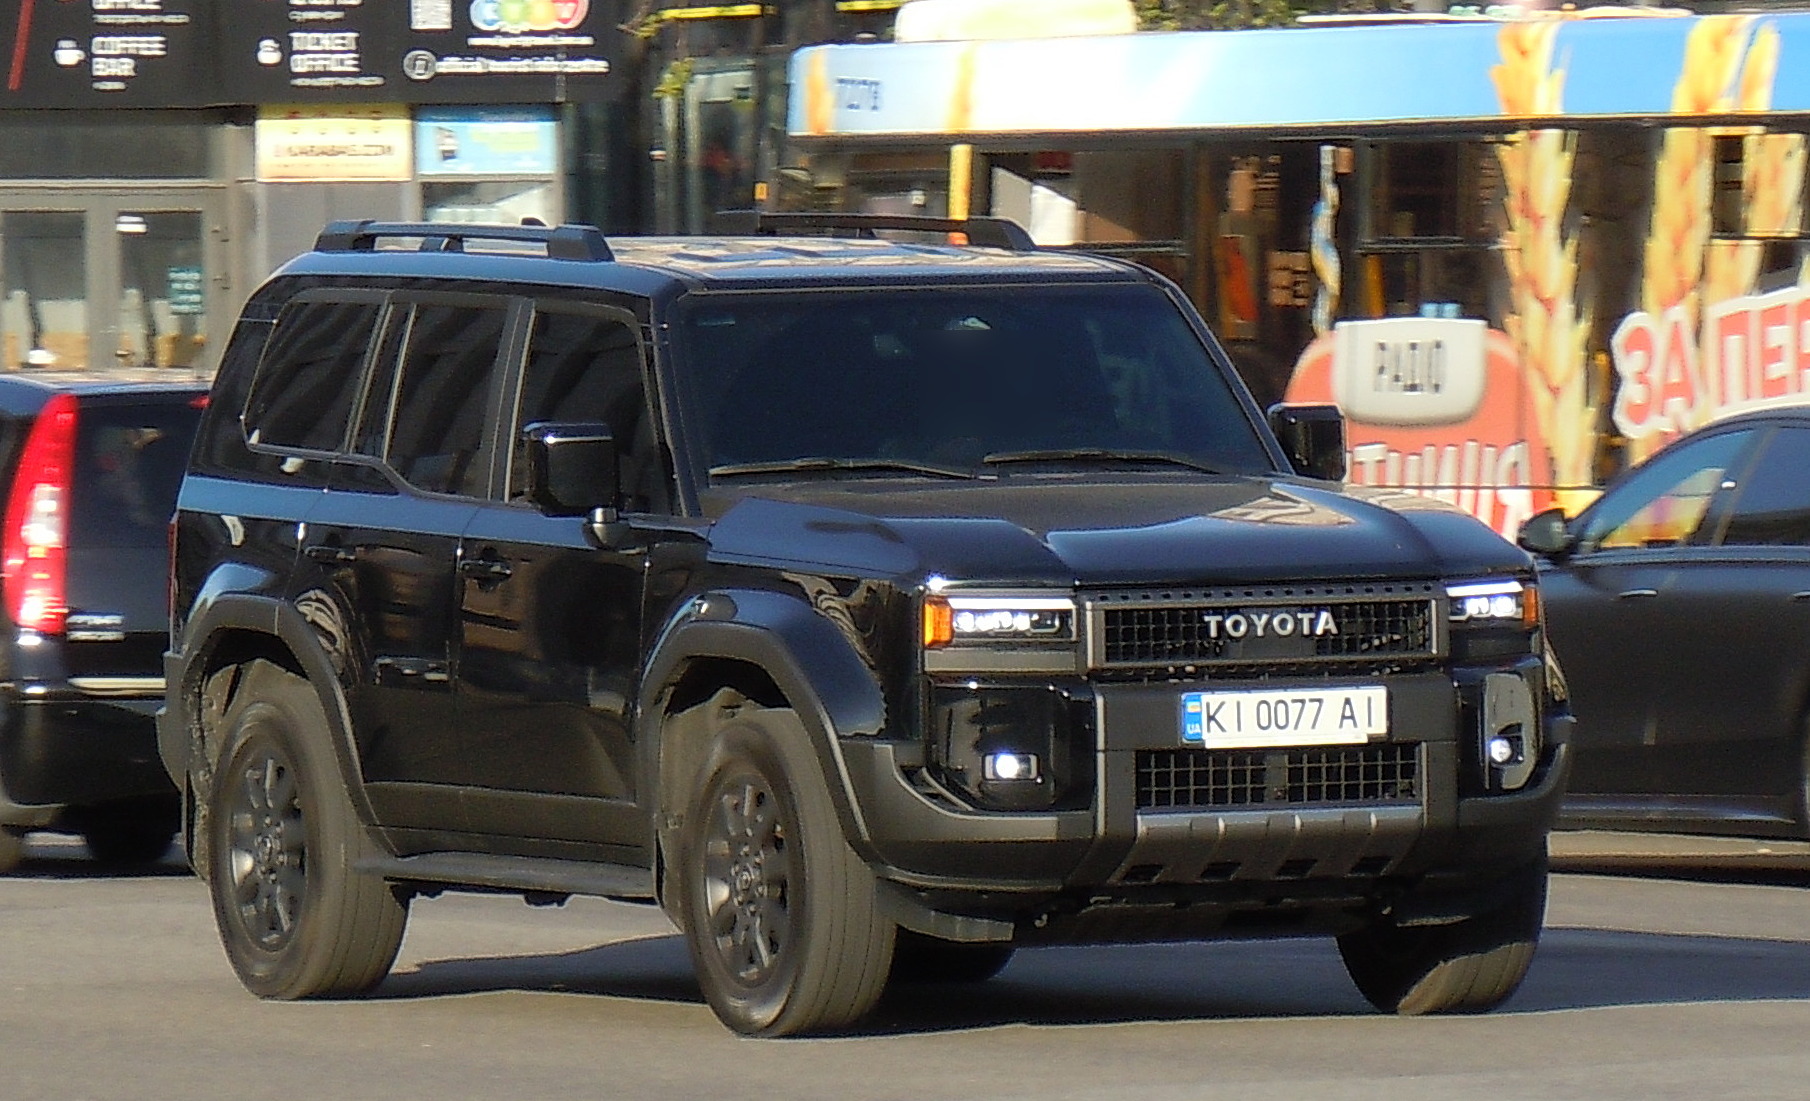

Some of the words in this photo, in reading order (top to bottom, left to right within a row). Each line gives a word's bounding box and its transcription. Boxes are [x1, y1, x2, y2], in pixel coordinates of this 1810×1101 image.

[91, 36, 167, 55] COFFEE
[91, 57, 136, 76] BAR
[1203, 611, 1339, 639] TOYOTA
[1205, 700, 1242, 734] KI
[1256, 697, 1325, 731] 0077
[1338, 695, 1373, 730] AI
[1186, 722, 1202, 735] UA
